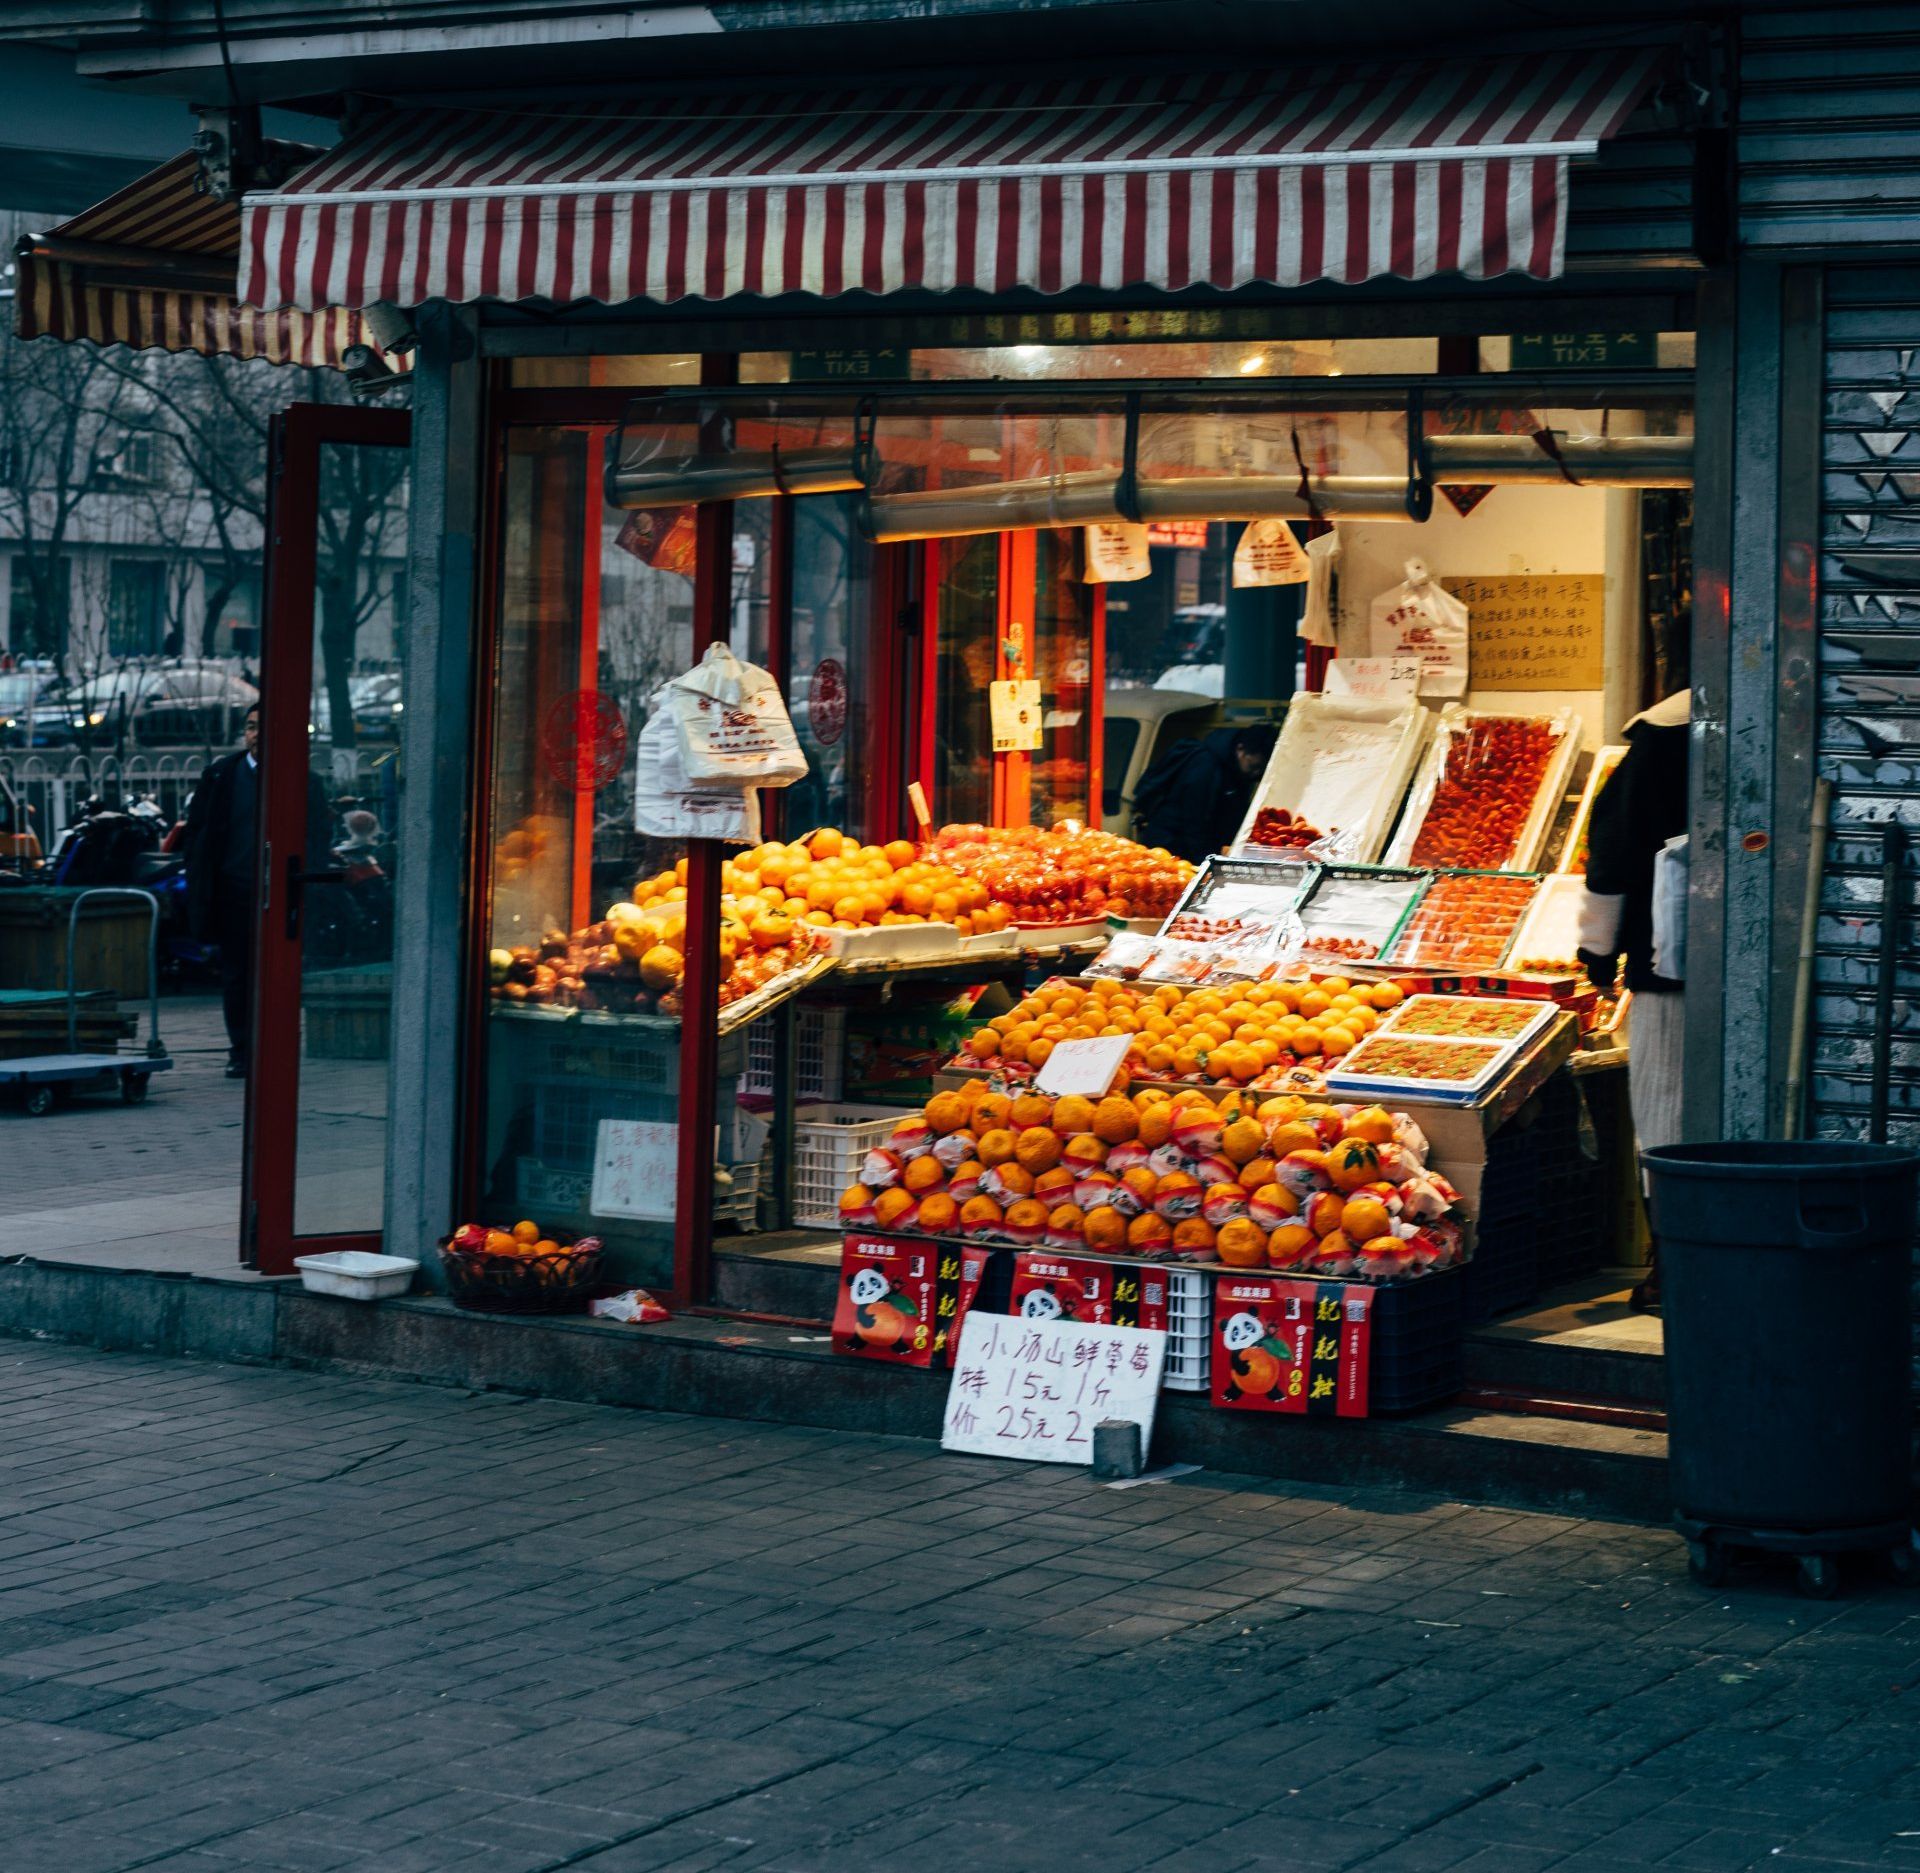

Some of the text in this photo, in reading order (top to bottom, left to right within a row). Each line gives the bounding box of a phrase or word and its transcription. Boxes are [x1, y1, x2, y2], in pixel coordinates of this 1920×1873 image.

[979, 1322, 1151, 1379] 小汤山鲜草莓
[959, 1365, 989, 1399] 特
[950, 1401, 980, 1435] 价
